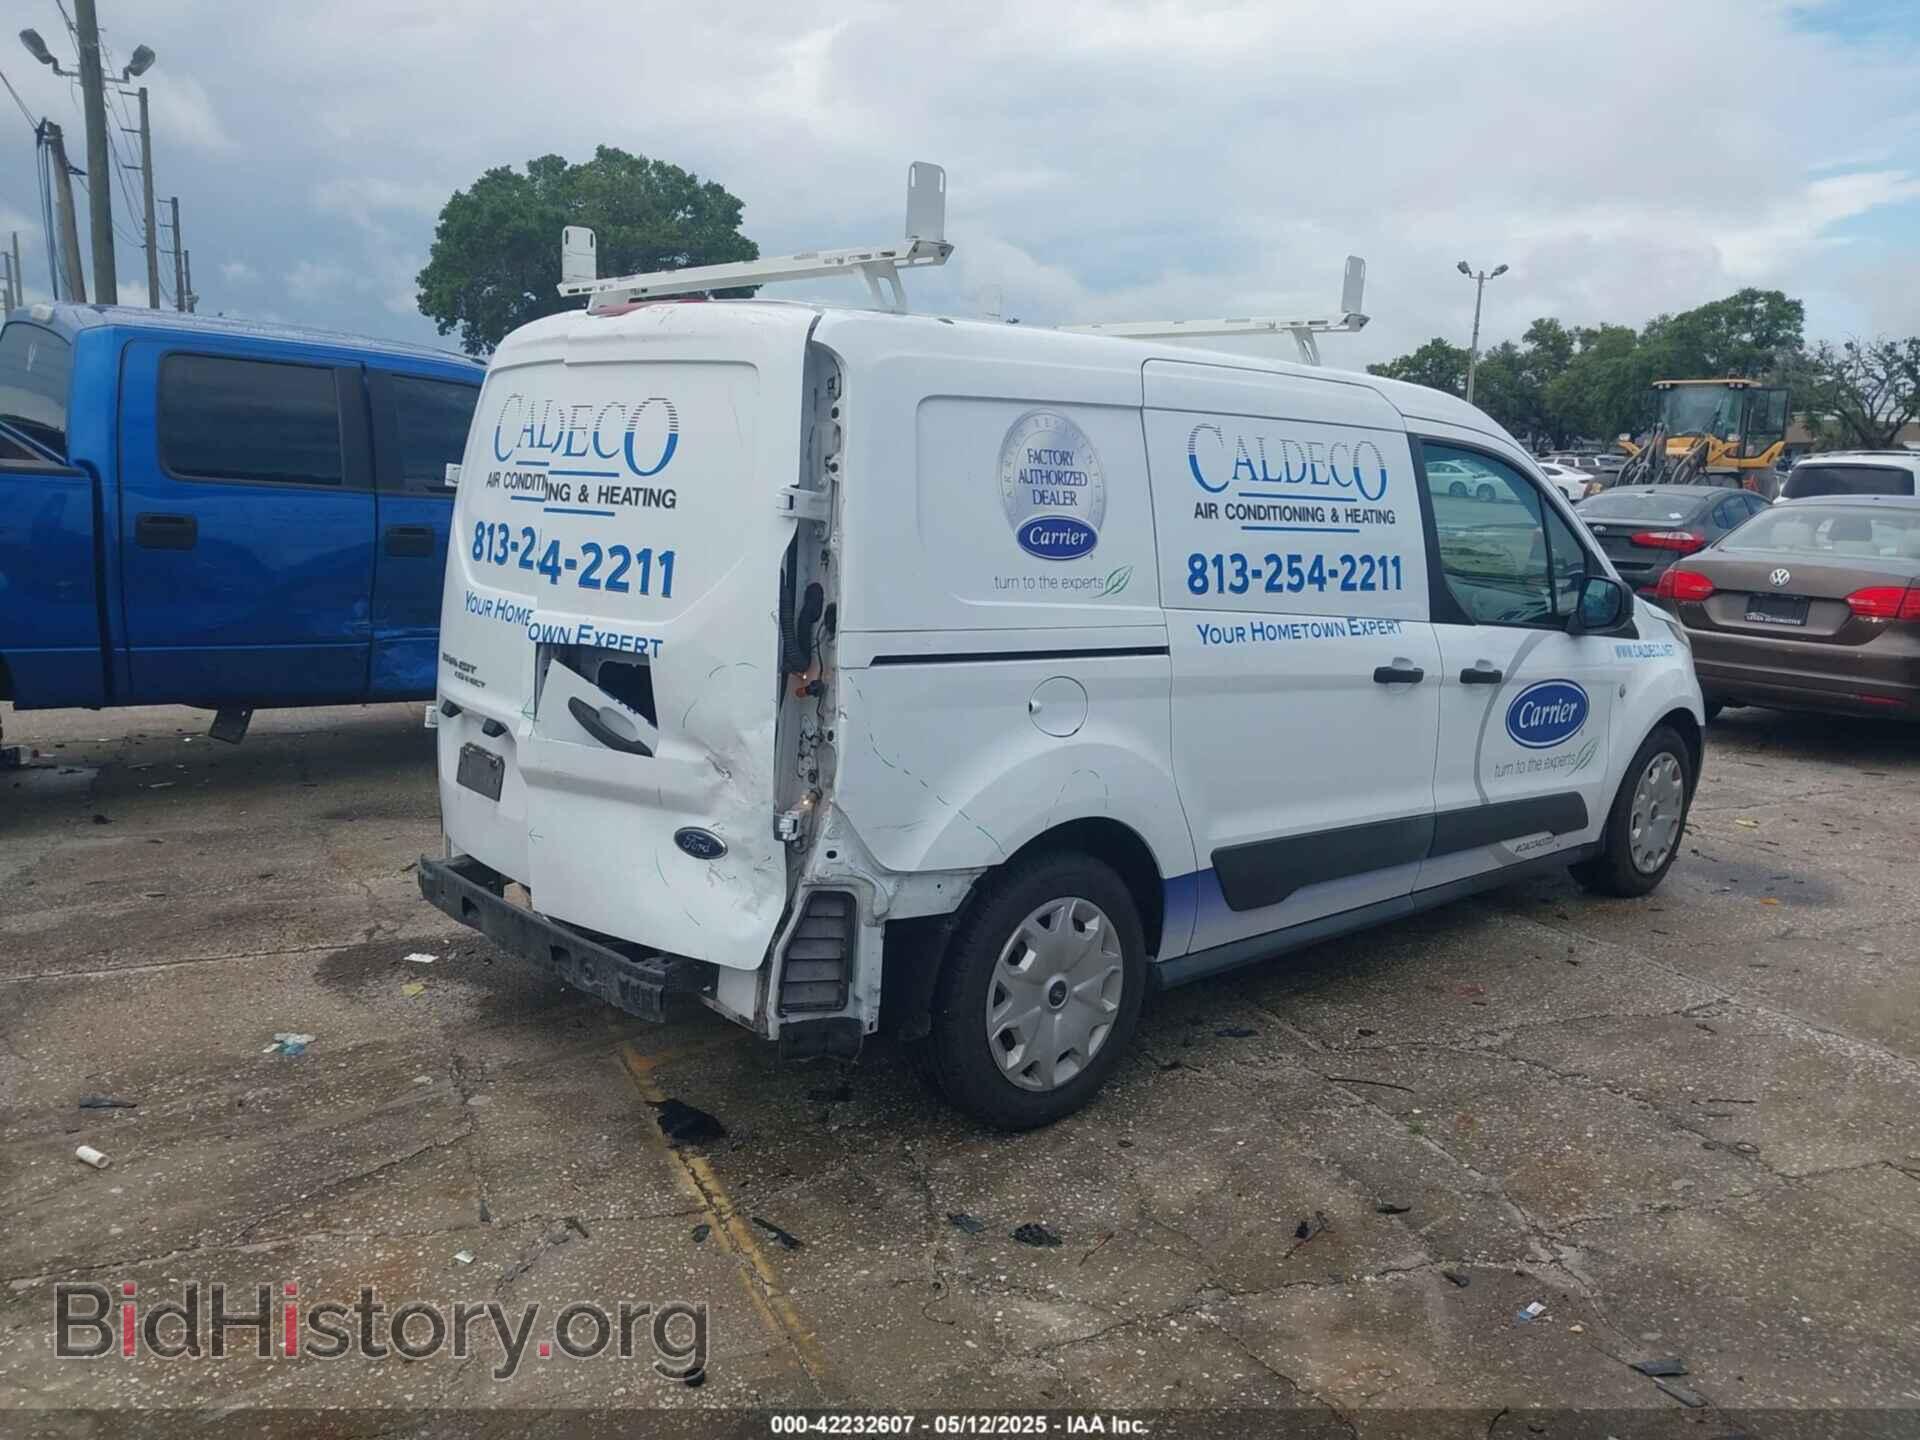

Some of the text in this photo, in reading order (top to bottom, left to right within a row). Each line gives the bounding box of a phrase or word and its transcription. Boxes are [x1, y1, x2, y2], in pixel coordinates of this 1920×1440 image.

[1027, 448, 1074, 466] FACTORY
[1188, 423, 1387, 500] CALDECO
[1018, 469, 1088, 487] AUTHORIZED
[486, 472, 500, 488] AIR
[578, 484, 589, 503] &
[597, 485, 677, 509] HEATING
[1032, 488, 1078, 506] DEALER
[1194, 502, 1396, 525] AIR CONDITIONING & HEATING
[1029, 526, 1088, 546] Carrier
[994, 576, 1104, 593] turn to the experts
[1188, 553, 1401, 595] 813-254-2211
[1197, 619, 1402, 645] YOUR HOMETOWN EXPERT
[1519, 697, 1579, 729] Carrier
[682, 832, 711, 853] Ford
